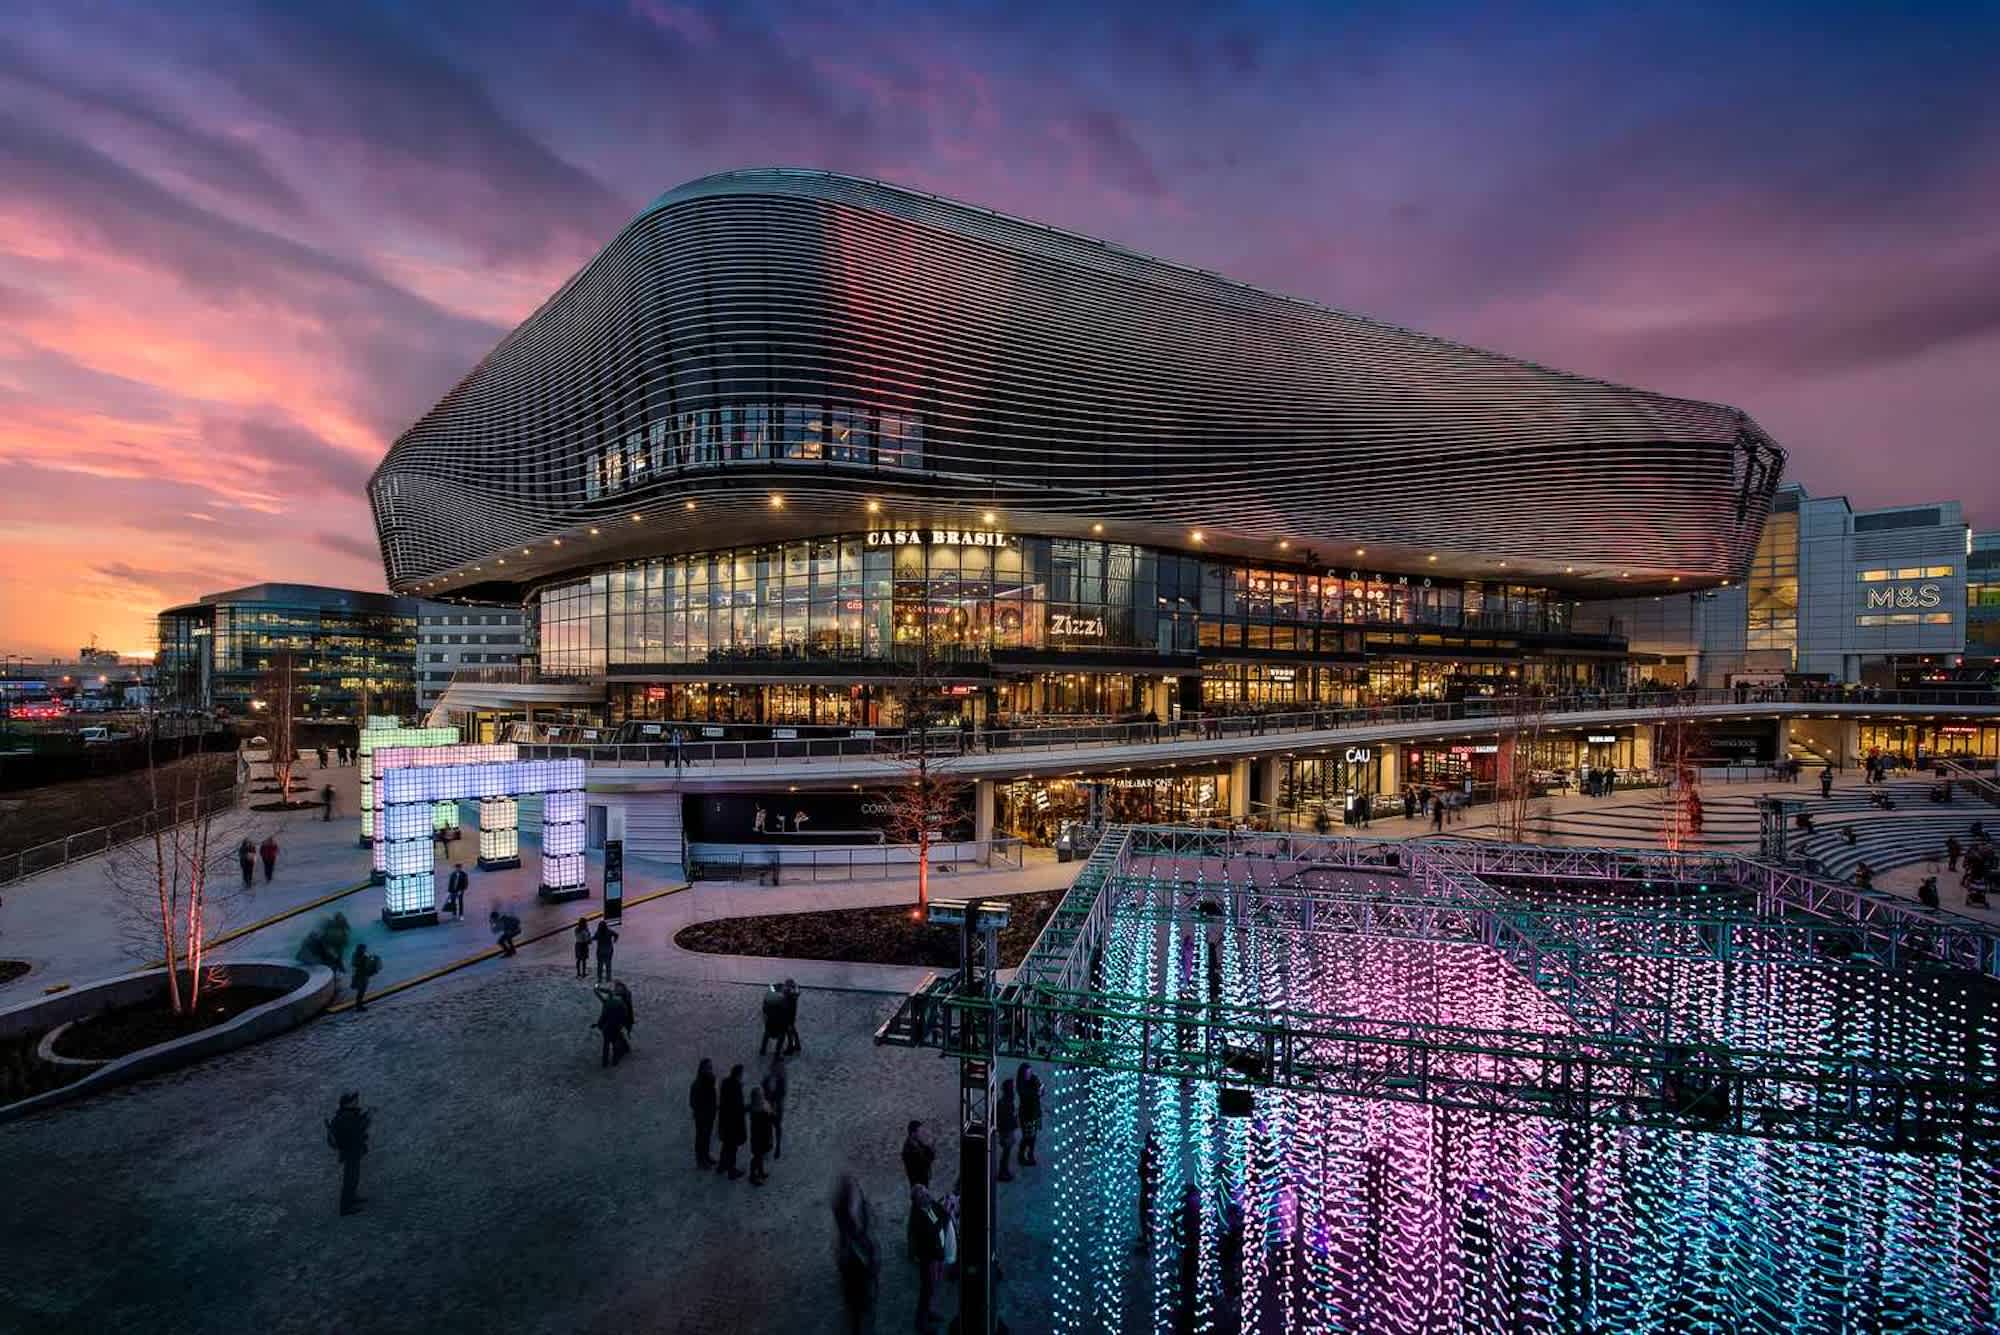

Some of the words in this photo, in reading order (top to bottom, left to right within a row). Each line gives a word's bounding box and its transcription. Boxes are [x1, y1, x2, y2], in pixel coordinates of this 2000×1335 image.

[867, 531, 921, 545] CASA
[932, 532, 1007, 546] BRASIL
[1328, 569, 1432, 588] COSMO
[1868, 584, 1940, 608] M&S
[1051, 615, 1104, 637] Zizzi
[1345, 749, 1371, 763] CAU
